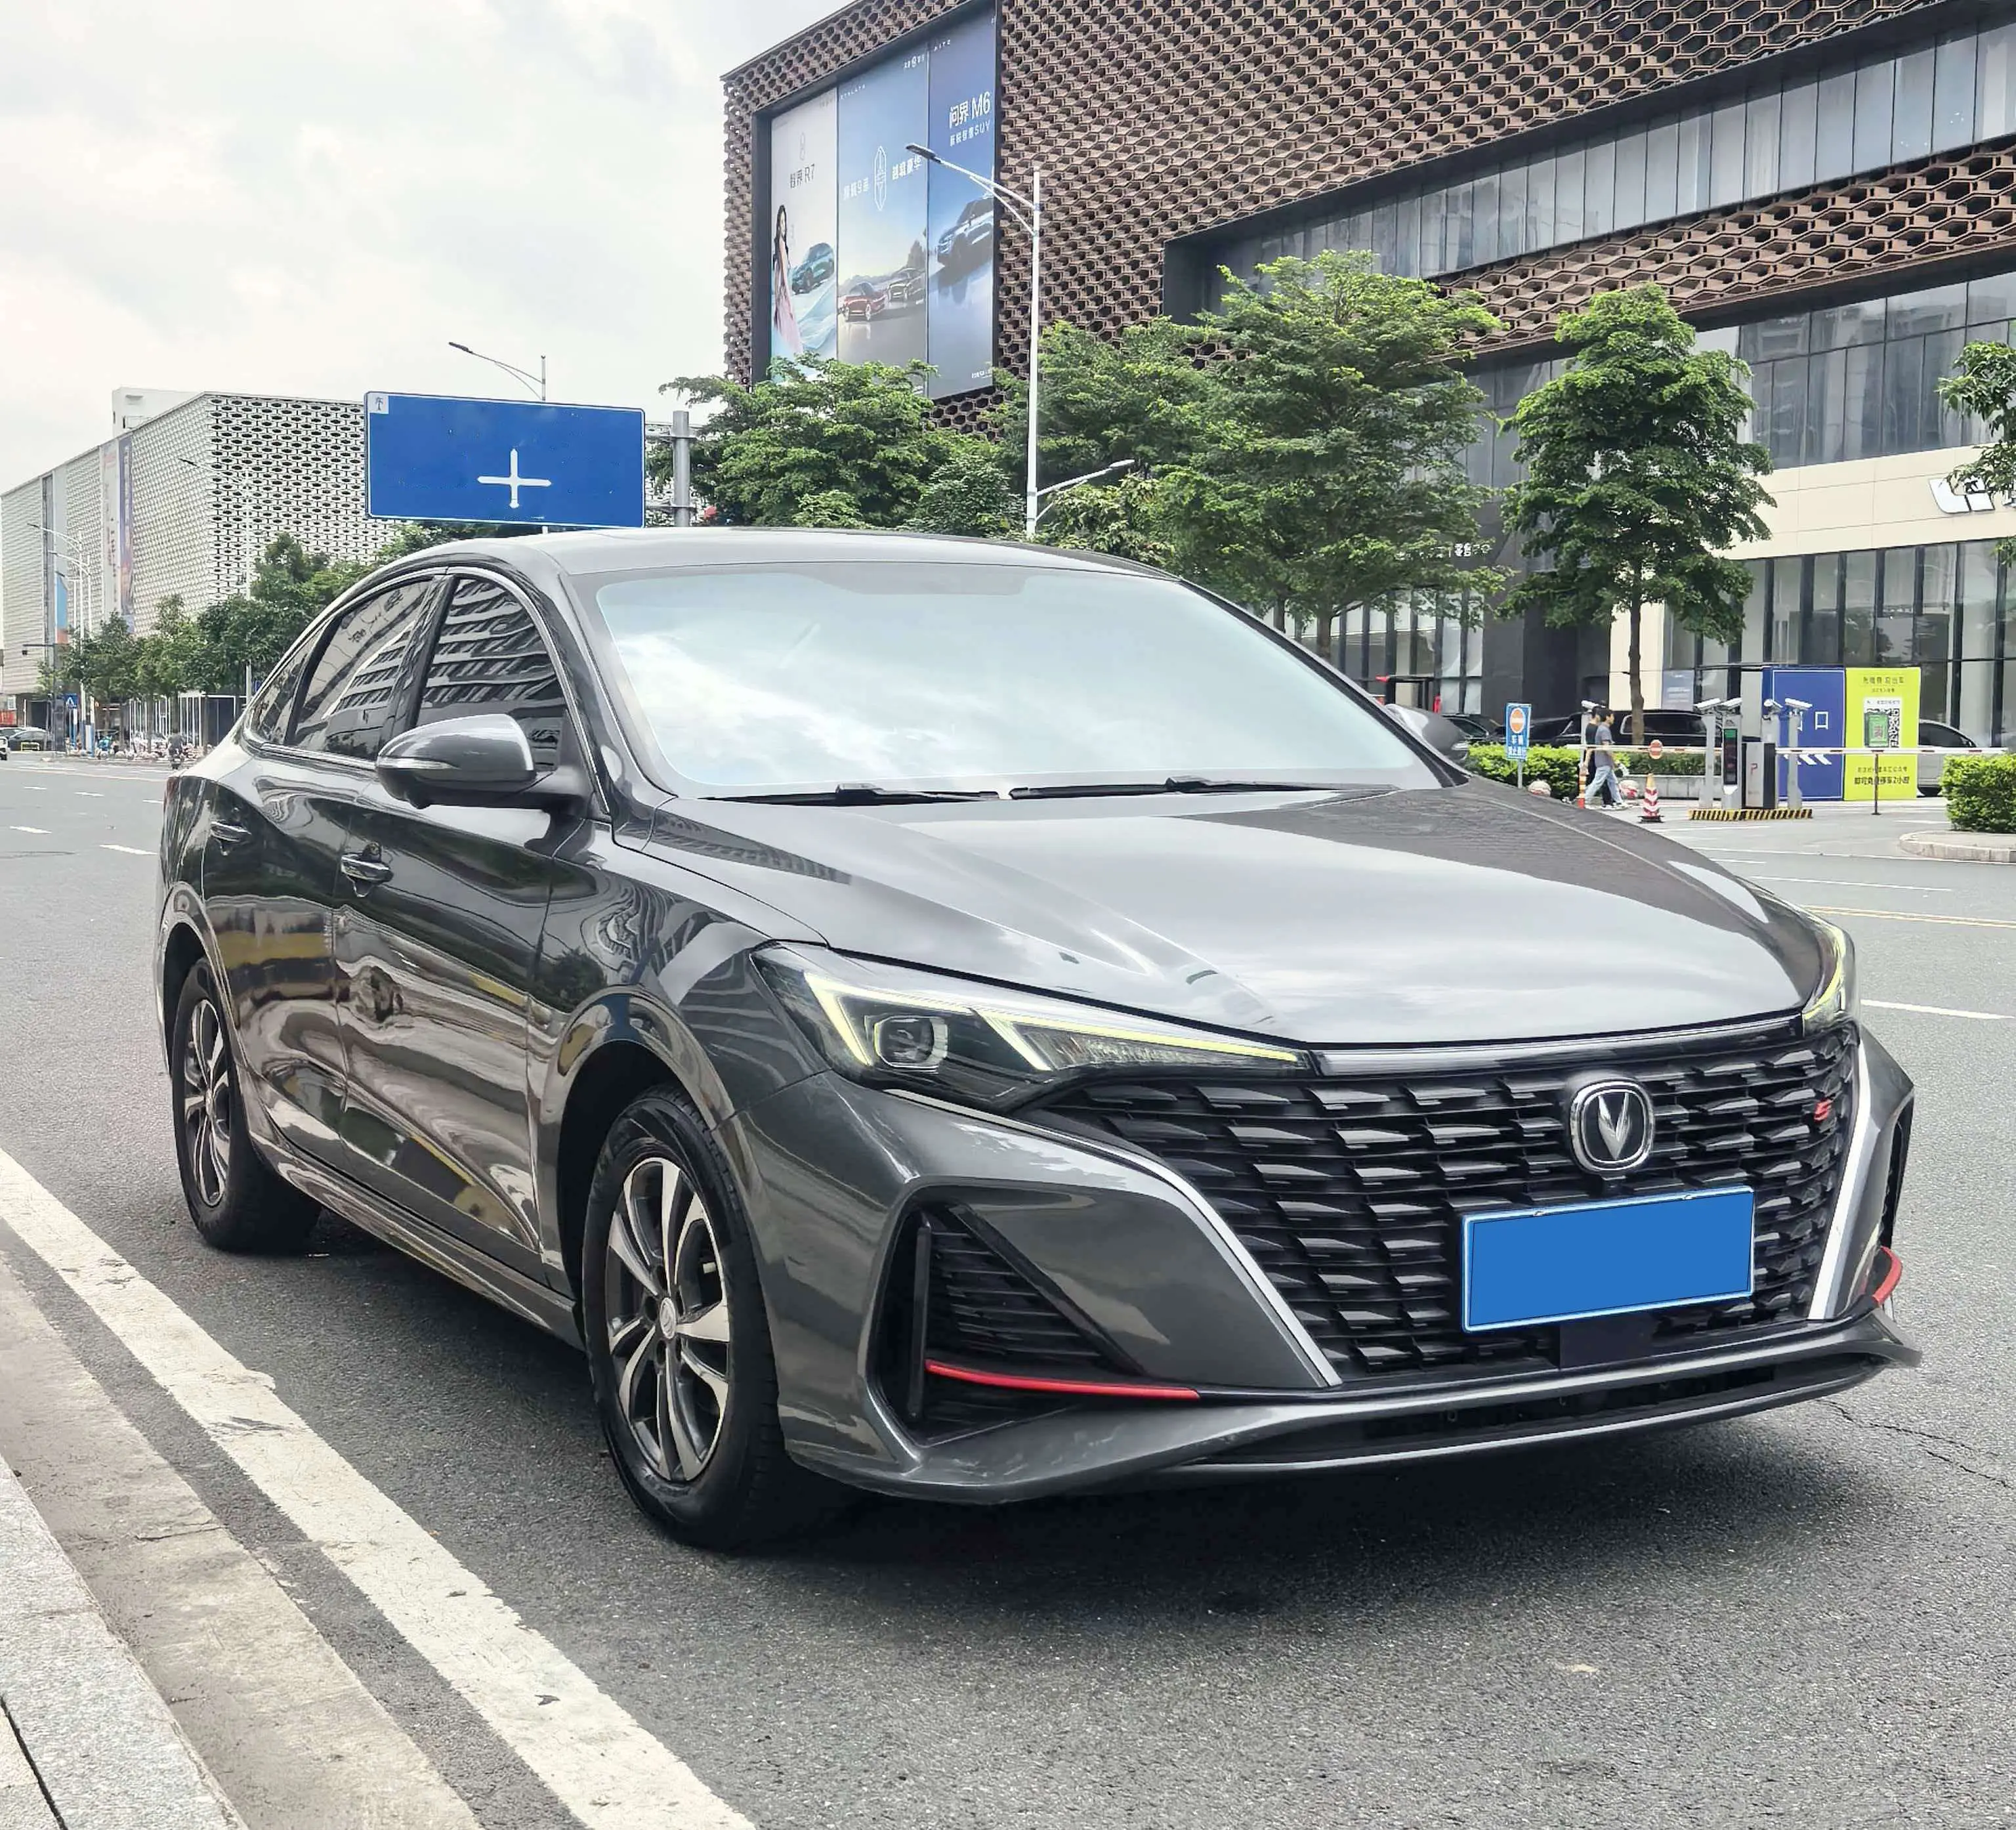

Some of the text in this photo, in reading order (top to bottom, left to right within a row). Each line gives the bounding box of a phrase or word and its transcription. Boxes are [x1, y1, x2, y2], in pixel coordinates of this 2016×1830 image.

[949, 91, 990, 129] 问界 M6
[805, 163, 815, 183] R7
